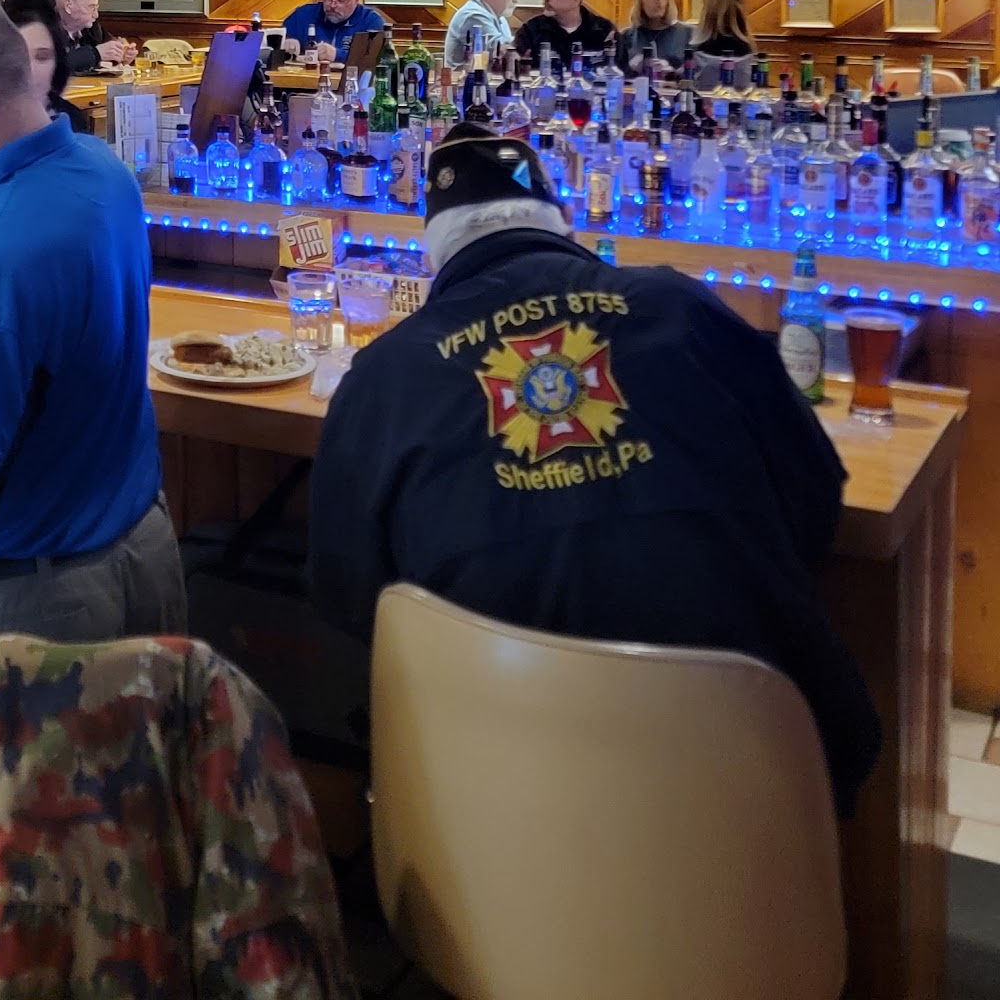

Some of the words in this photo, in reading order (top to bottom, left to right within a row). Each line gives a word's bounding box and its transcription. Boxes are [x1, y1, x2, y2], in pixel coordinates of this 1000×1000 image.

[436, 320, 486, 359] VFW
[493, 295, 557, 334] POST
[565, 291, 630, 315] 8755
